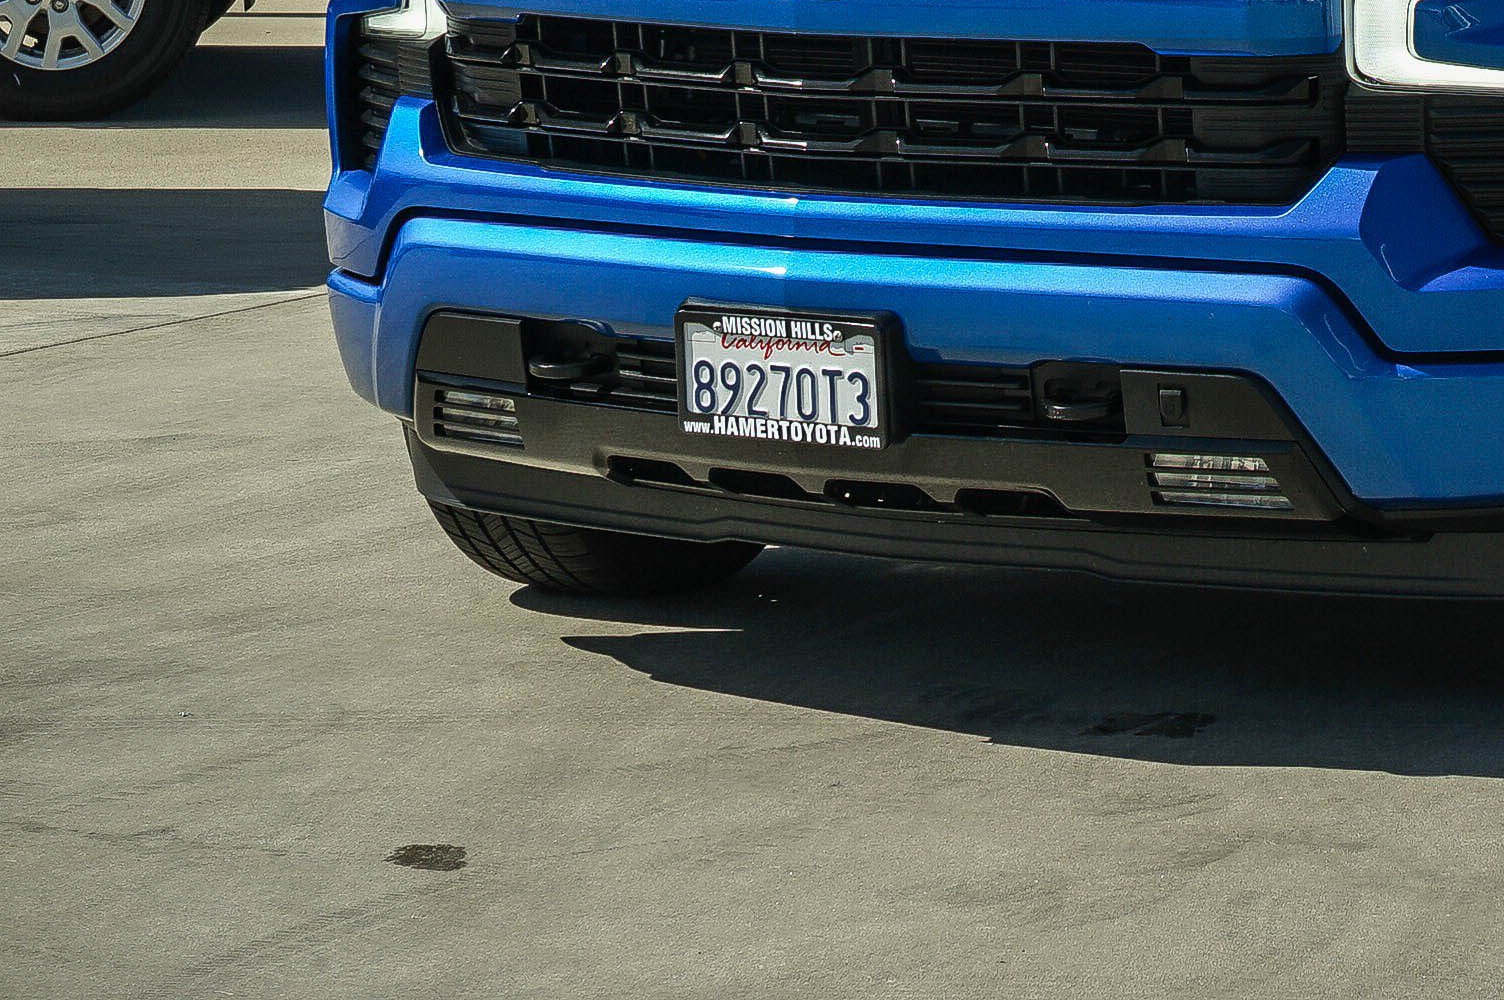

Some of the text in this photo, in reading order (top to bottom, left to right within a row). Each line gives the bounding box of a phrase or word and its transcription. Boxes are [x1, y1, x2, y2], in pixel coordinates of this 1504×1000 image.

[721, 316, 833, 342] MISSION HILLS
[721, 333, 846, 360] California
[694, 359, 871, 426] 89270T3
[683, 415, 881, 449] www.HAMERTOYOTA.com
